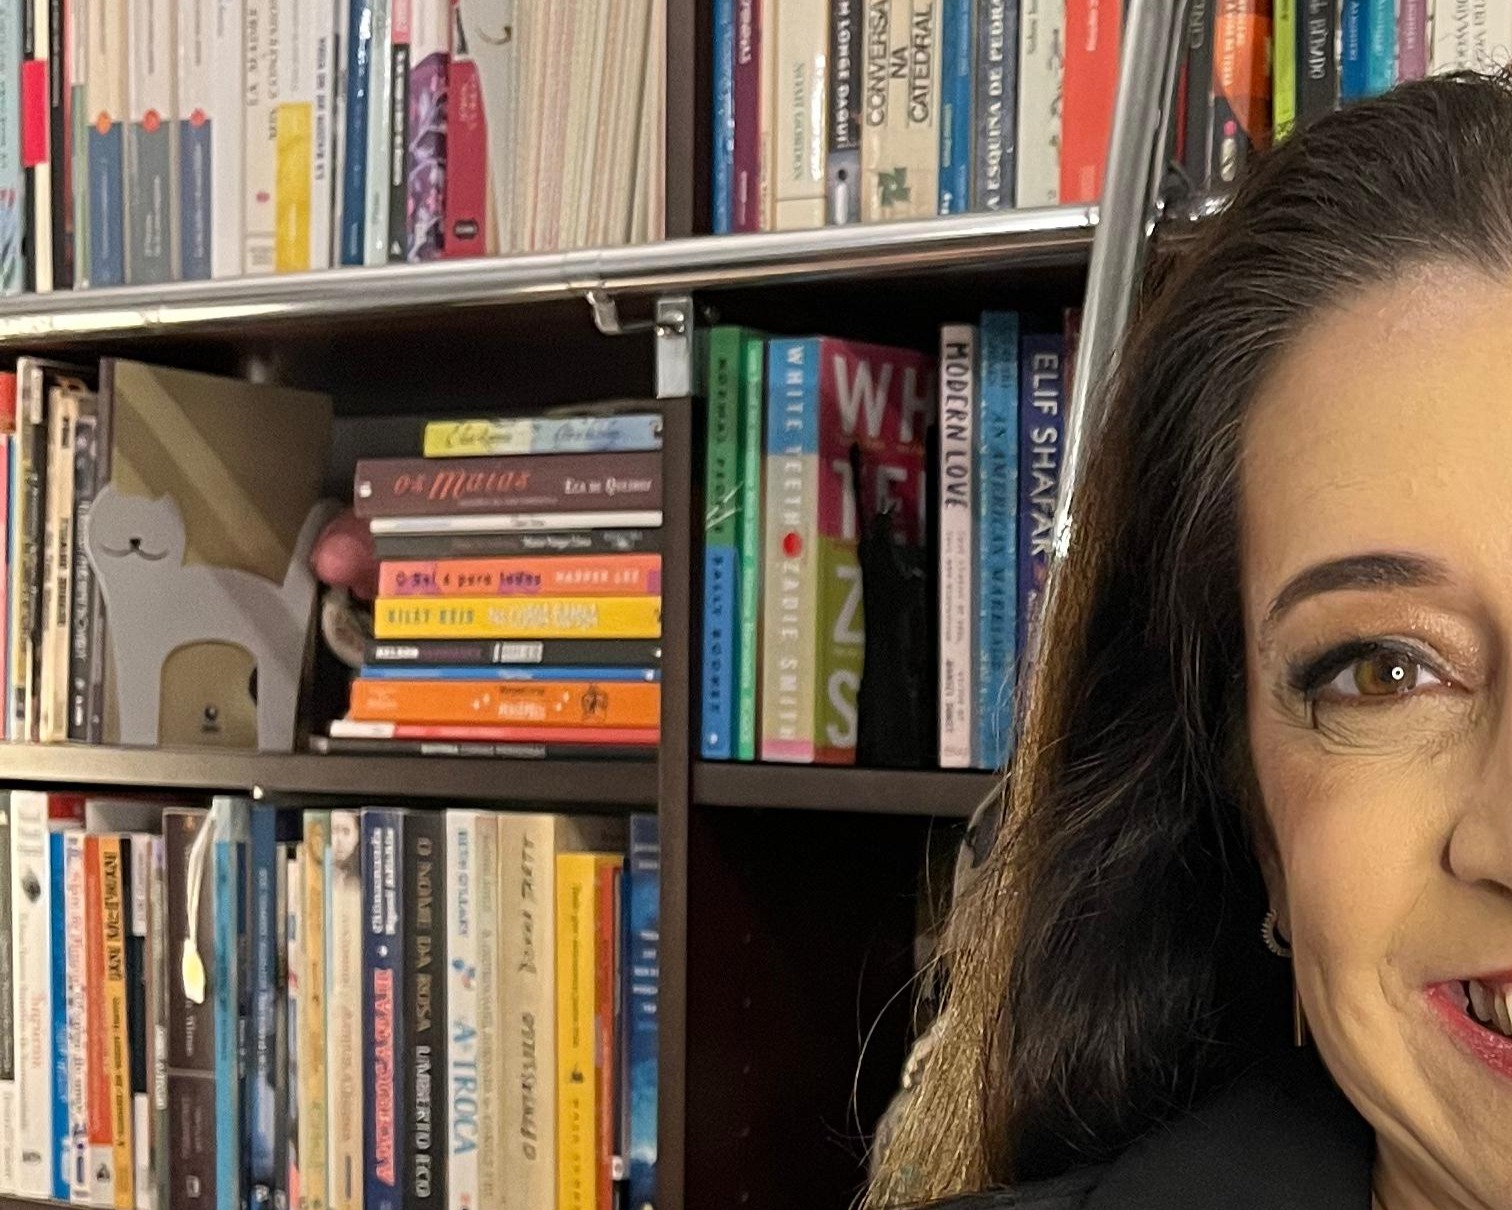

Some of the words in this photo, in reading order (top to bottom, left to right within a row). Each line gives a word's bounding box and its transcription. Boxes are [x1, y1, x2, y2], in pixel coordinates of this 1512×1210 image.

[866, 0, 890, 127] CONVERSA
[891, 48, 908, 78] NA
[908, 3, 933, 123] CATEDRAL
[988, 66, 1003, 96] DE
[987, 101, 1003, 190] ESQUINA
[785, 345, 804, 432] WHITE
[945, 342, 968, 440] MODERN
[1032, 354, 1058, 416] ELIF
[782, 447, 804, 528] TEETH
[944, 452, 968, 509] LOVE
[781, 561, 801, 641] ZADIE
[778, 656, 800, 741] SMITH
[416, 837, 432, 855] O
[416, 861, 432, 927] NOME
[416, 936, 432, 968] DA
[416, 973, 432, 1032] ROSA
[415, 1045, 431, 1149] UMBERTO
[453, 1060, 477, 1154] TROCA
[415, 1154, 431, 1197] ECO
